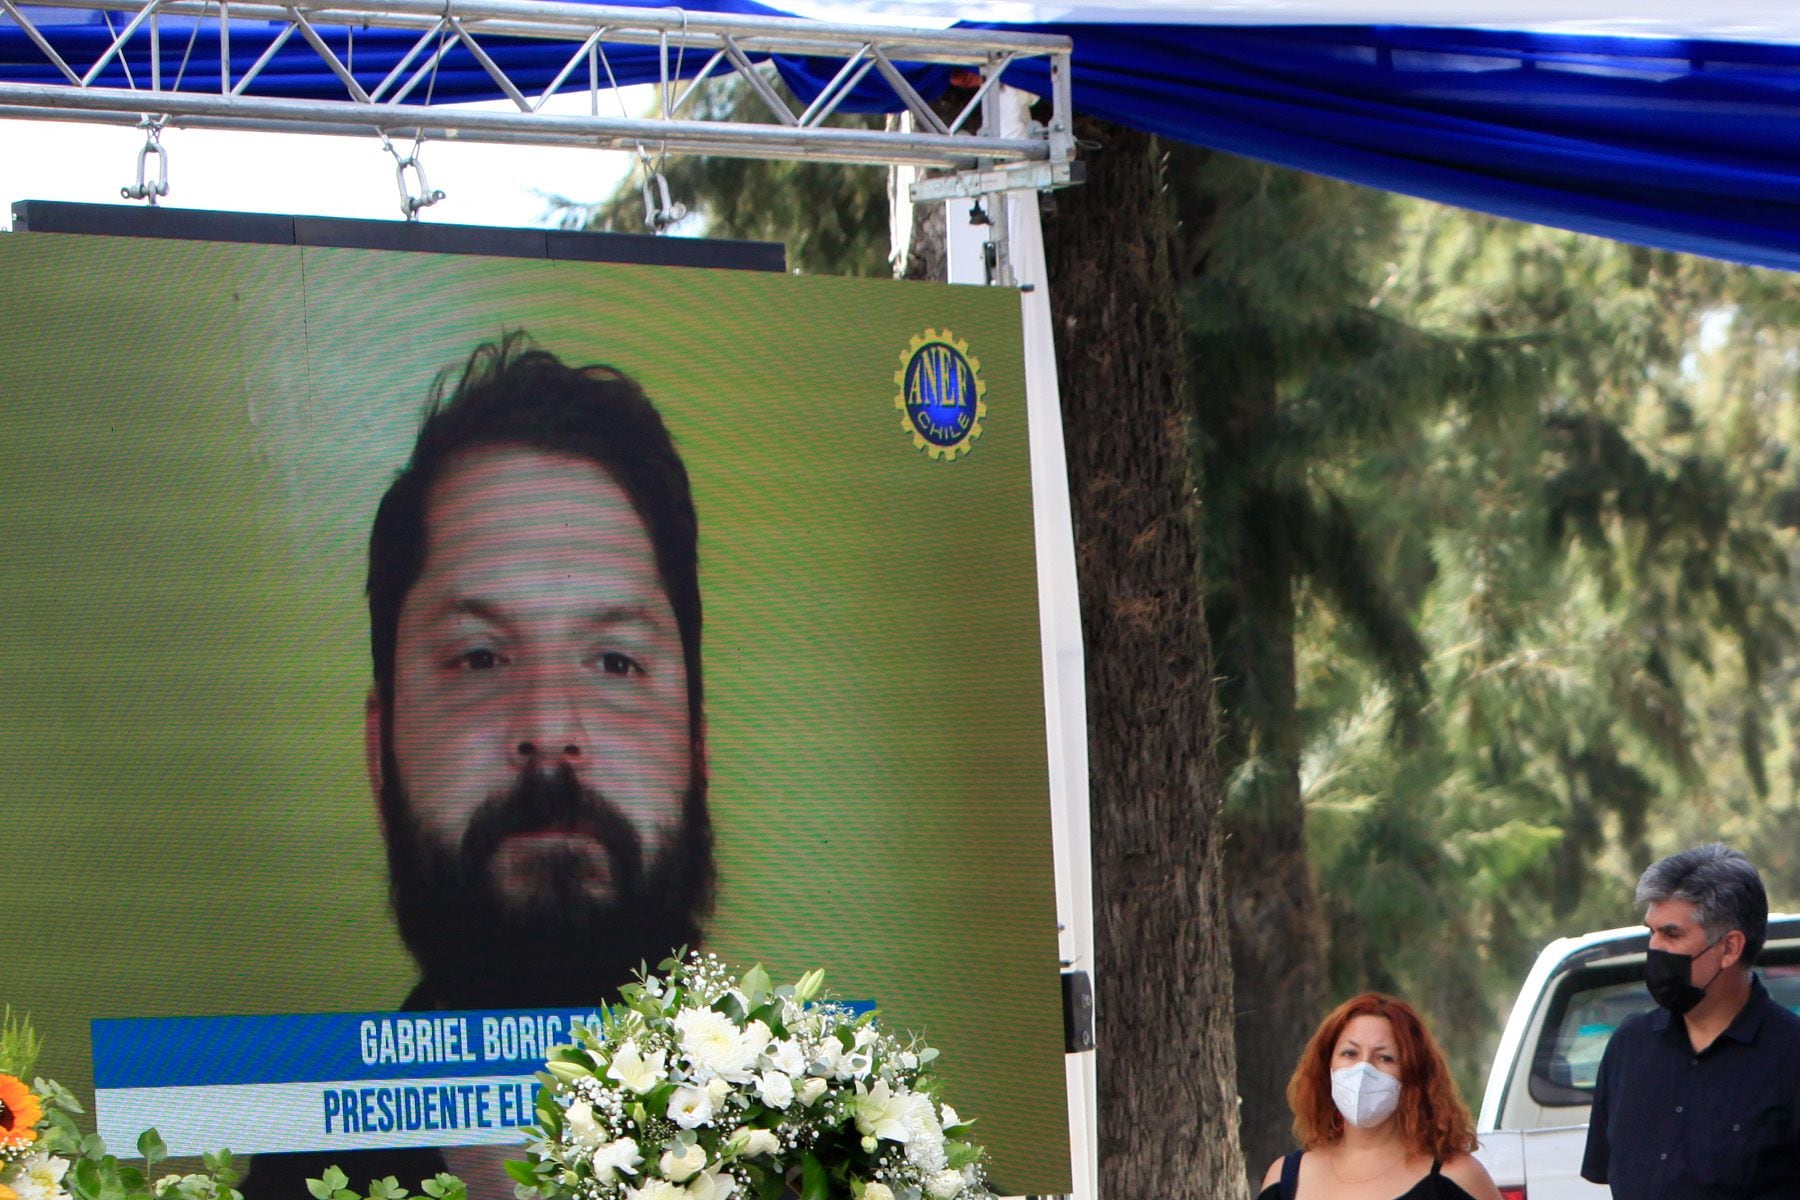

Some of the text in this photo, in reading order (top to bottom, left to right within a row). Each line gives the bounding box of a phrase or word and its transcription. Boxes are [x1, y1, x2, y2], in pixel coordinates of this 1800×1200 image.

[907, 346, 967, 407] ANEF
[918, 411, 970, 440] CHILE
[361, 1017, 476, 1065] GABRIEL
[482, 1015, 563, 1062] BORIC
[323, 1083, 492, 1134] PRESIDENTE
